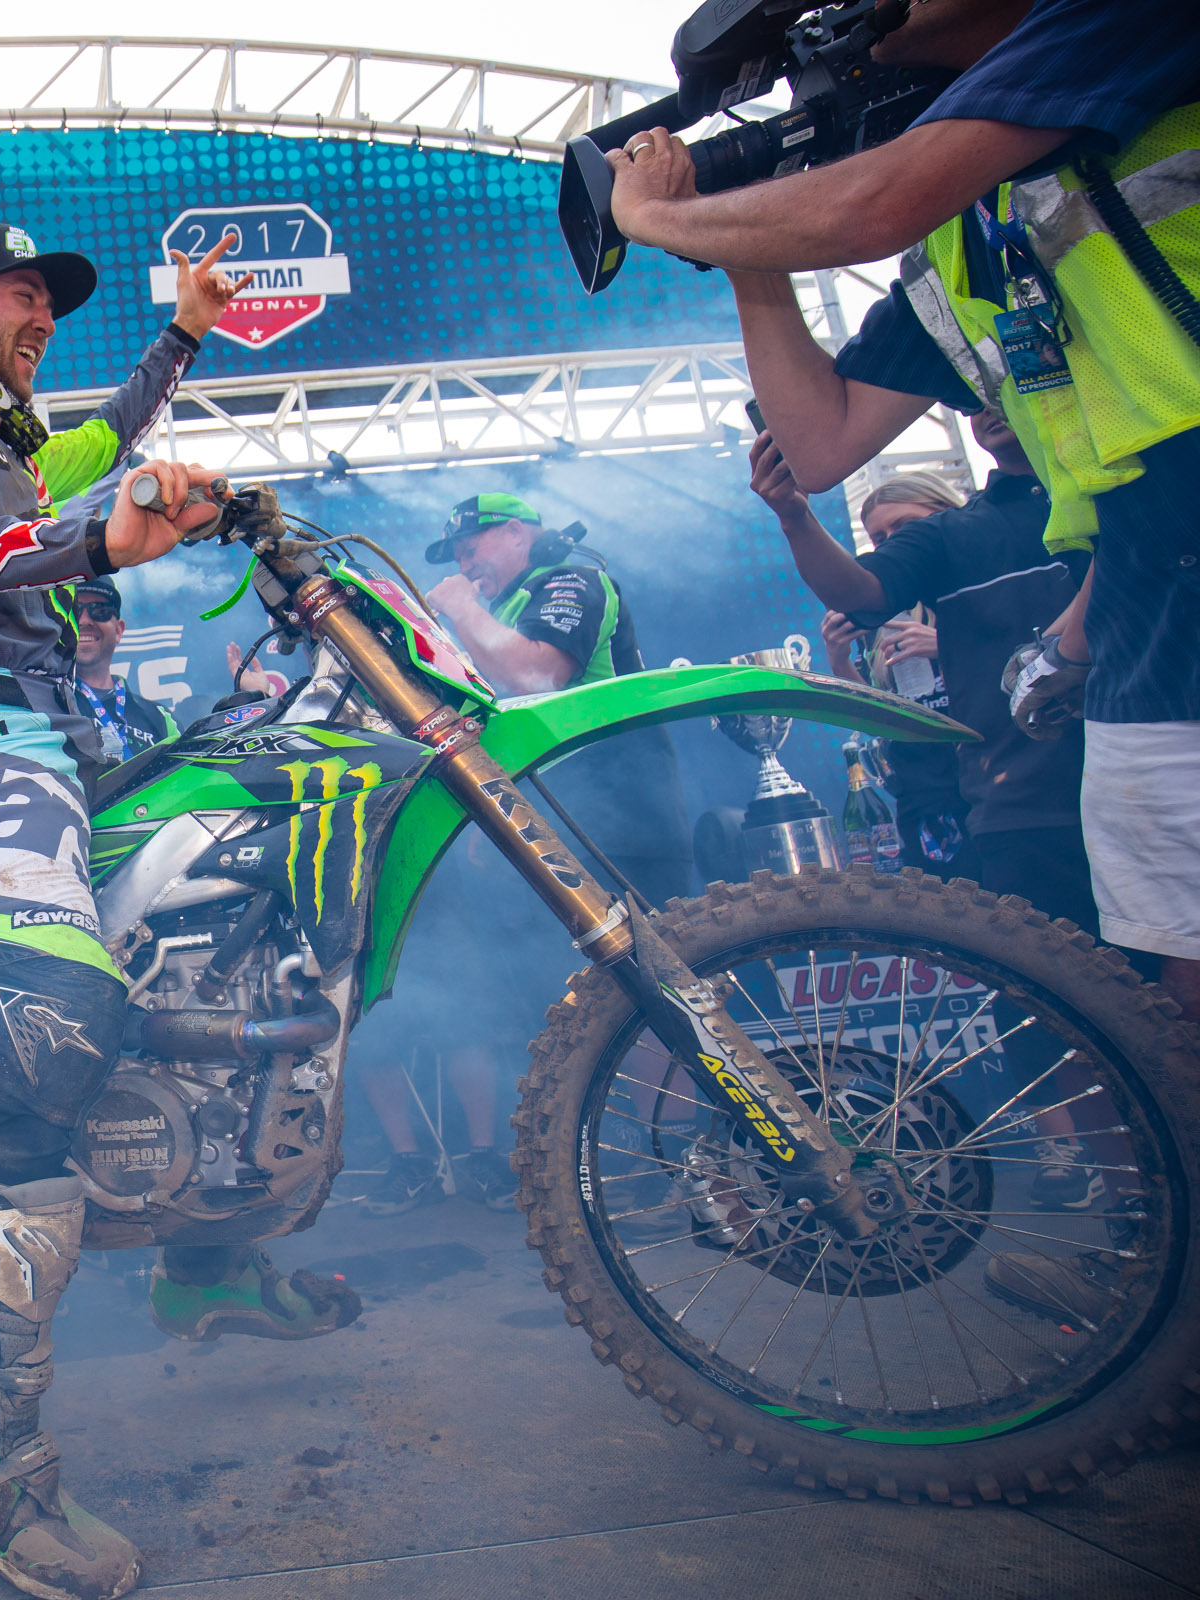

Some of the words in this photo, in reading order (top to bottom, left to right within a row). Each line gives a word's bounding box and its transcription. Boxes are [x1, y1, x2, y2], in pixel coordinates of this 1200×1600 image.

[187, 219, 305, 258] 2017
[223, 299, 308, 312] TIONAL
[1005, 341, 1031, 354] 2017
[1018, 376, 1035, 386] ALL
[1037, 369, 1071, 381] ACCESS
[1017, 384, 1027, 394] TV
[77, 585, 114, 597] wasaki
[303, 586, 326, 608] XTRIG
[312, 597, 337, 621] ROCS
[413, 711, 448, 740] XTRIG
[13, 908, 101, 938] Kawas
[793, 958, 939, 1007] LUCAS
[858, 997, 969, 1023] PRO
[86, 1115, 166, 1134] Kawasaki
[97, 1133, 131, 1142] Racing
[131, 1131, 158, 1140] Team
[90, 1147, 169, 1164] HINSON
